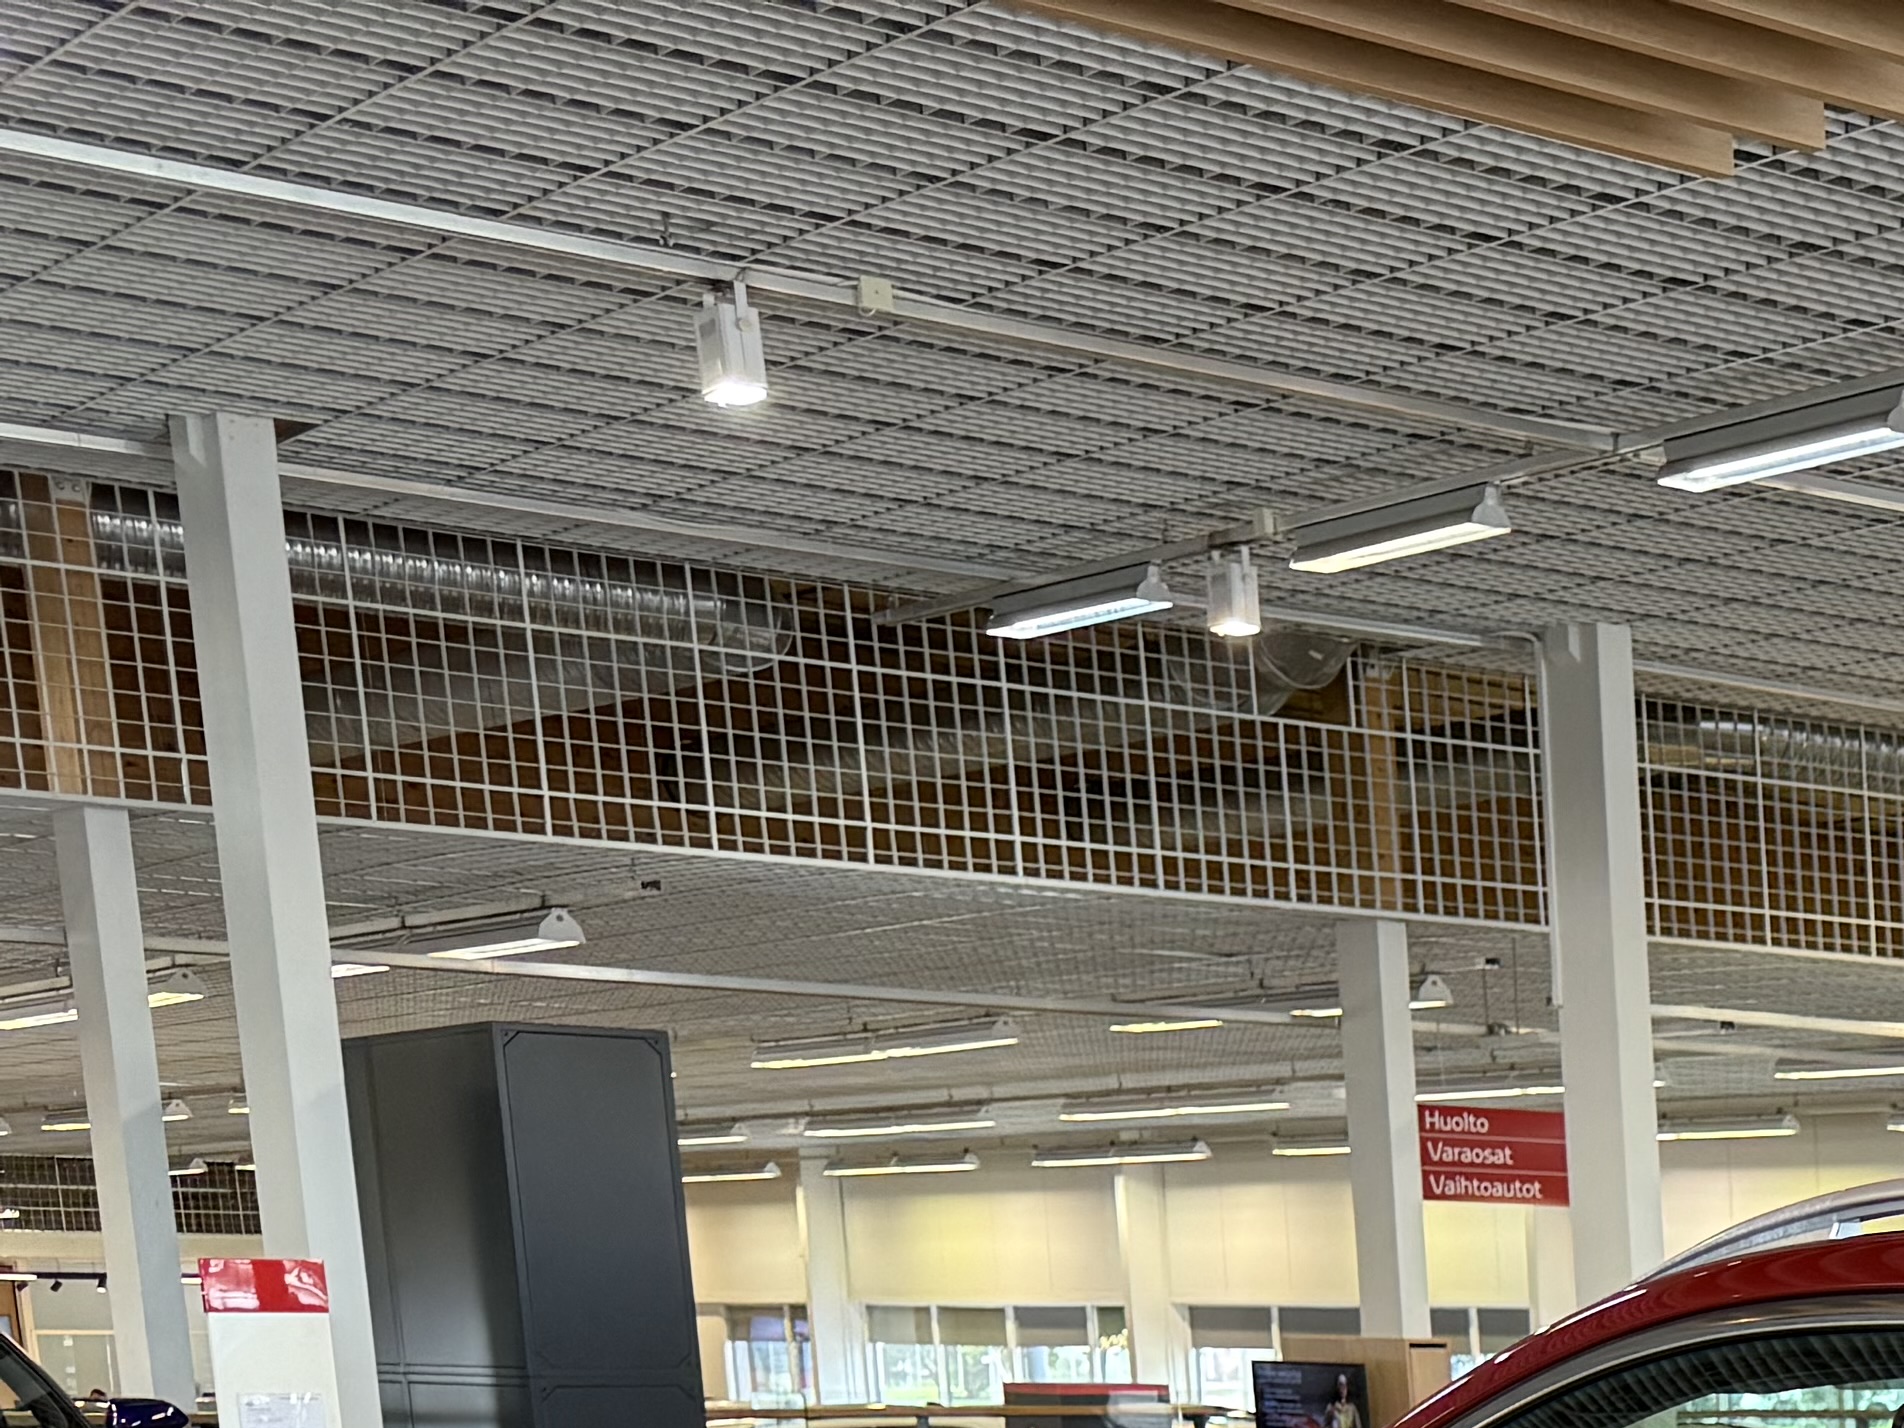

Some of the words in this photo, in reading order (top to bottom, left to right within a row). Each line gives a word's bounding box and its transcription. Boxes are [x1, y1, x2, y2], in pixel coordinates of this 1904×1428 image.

[1424, 1109, 1489, 1134] Huolto
[1427, 1140, 1514, 1166] Varaosat
[1429, 1173, 1543, 1200] Vaihtoautot
